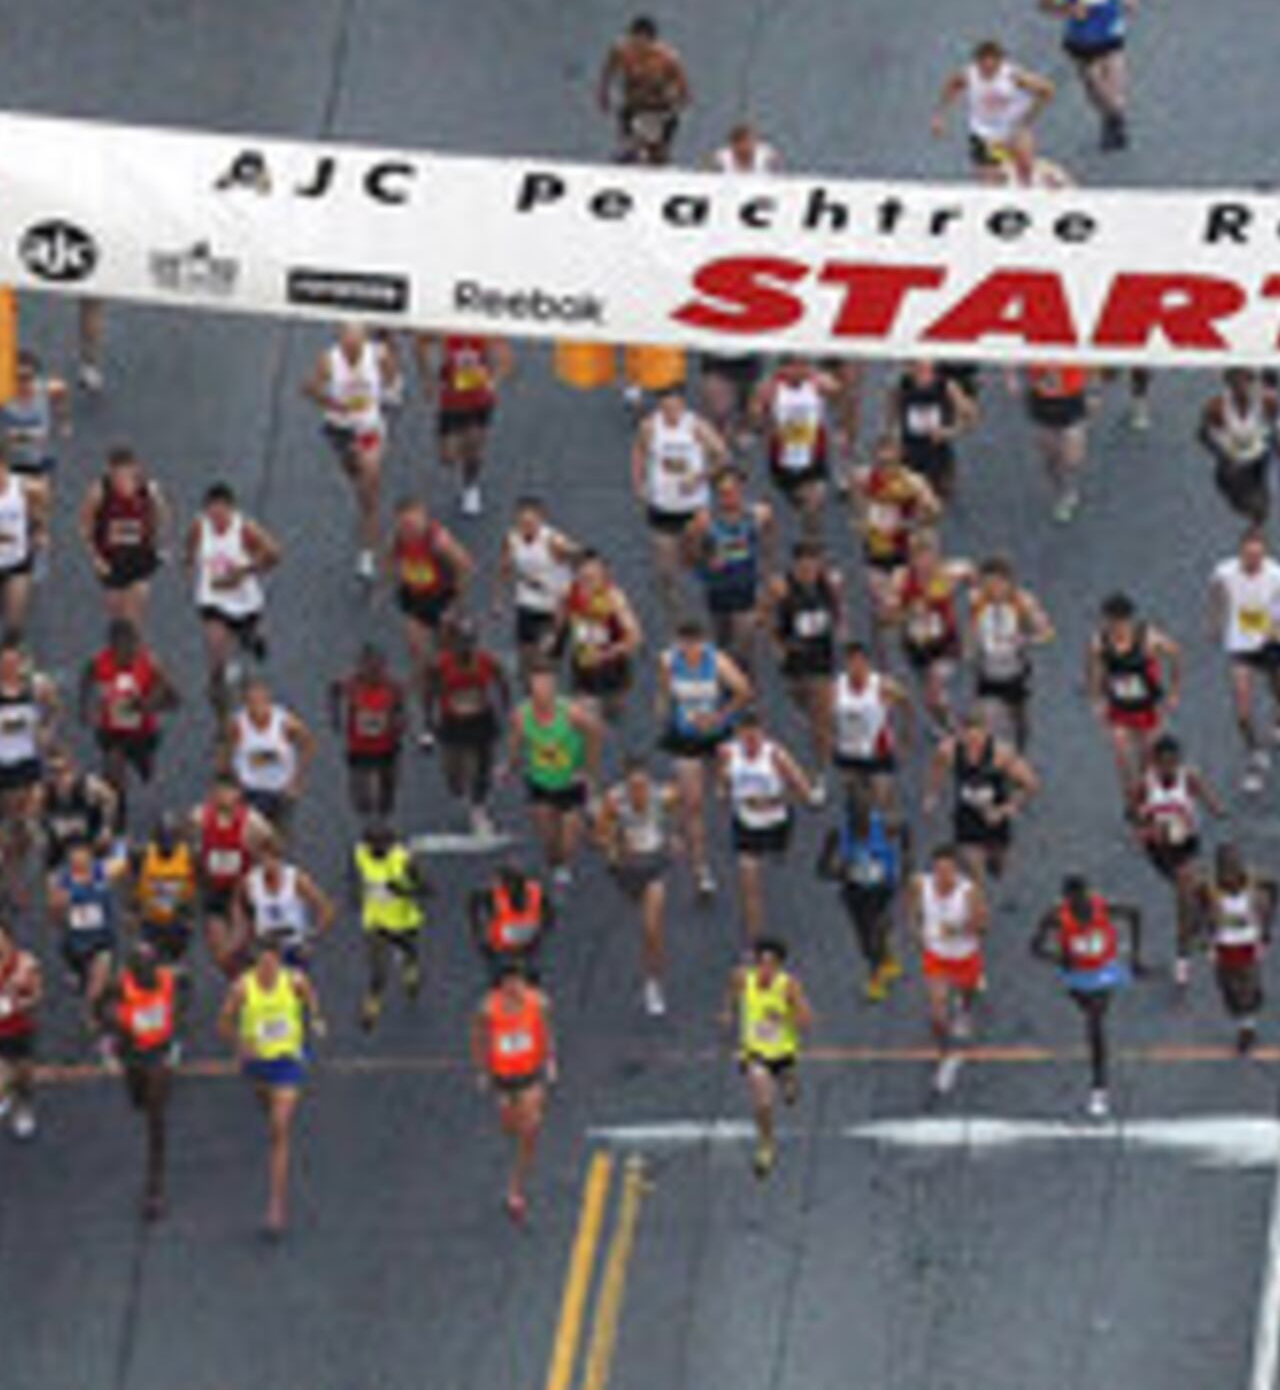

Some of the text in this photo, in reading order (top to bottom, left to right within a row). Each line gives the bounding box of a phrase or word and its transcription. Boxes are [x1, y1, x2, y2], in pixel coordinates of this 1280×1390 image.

[214, 151, 414, 204] AJC
[516, 171, 1098, 244] Peachtree
[453, 280, 604, 322] Reebok
